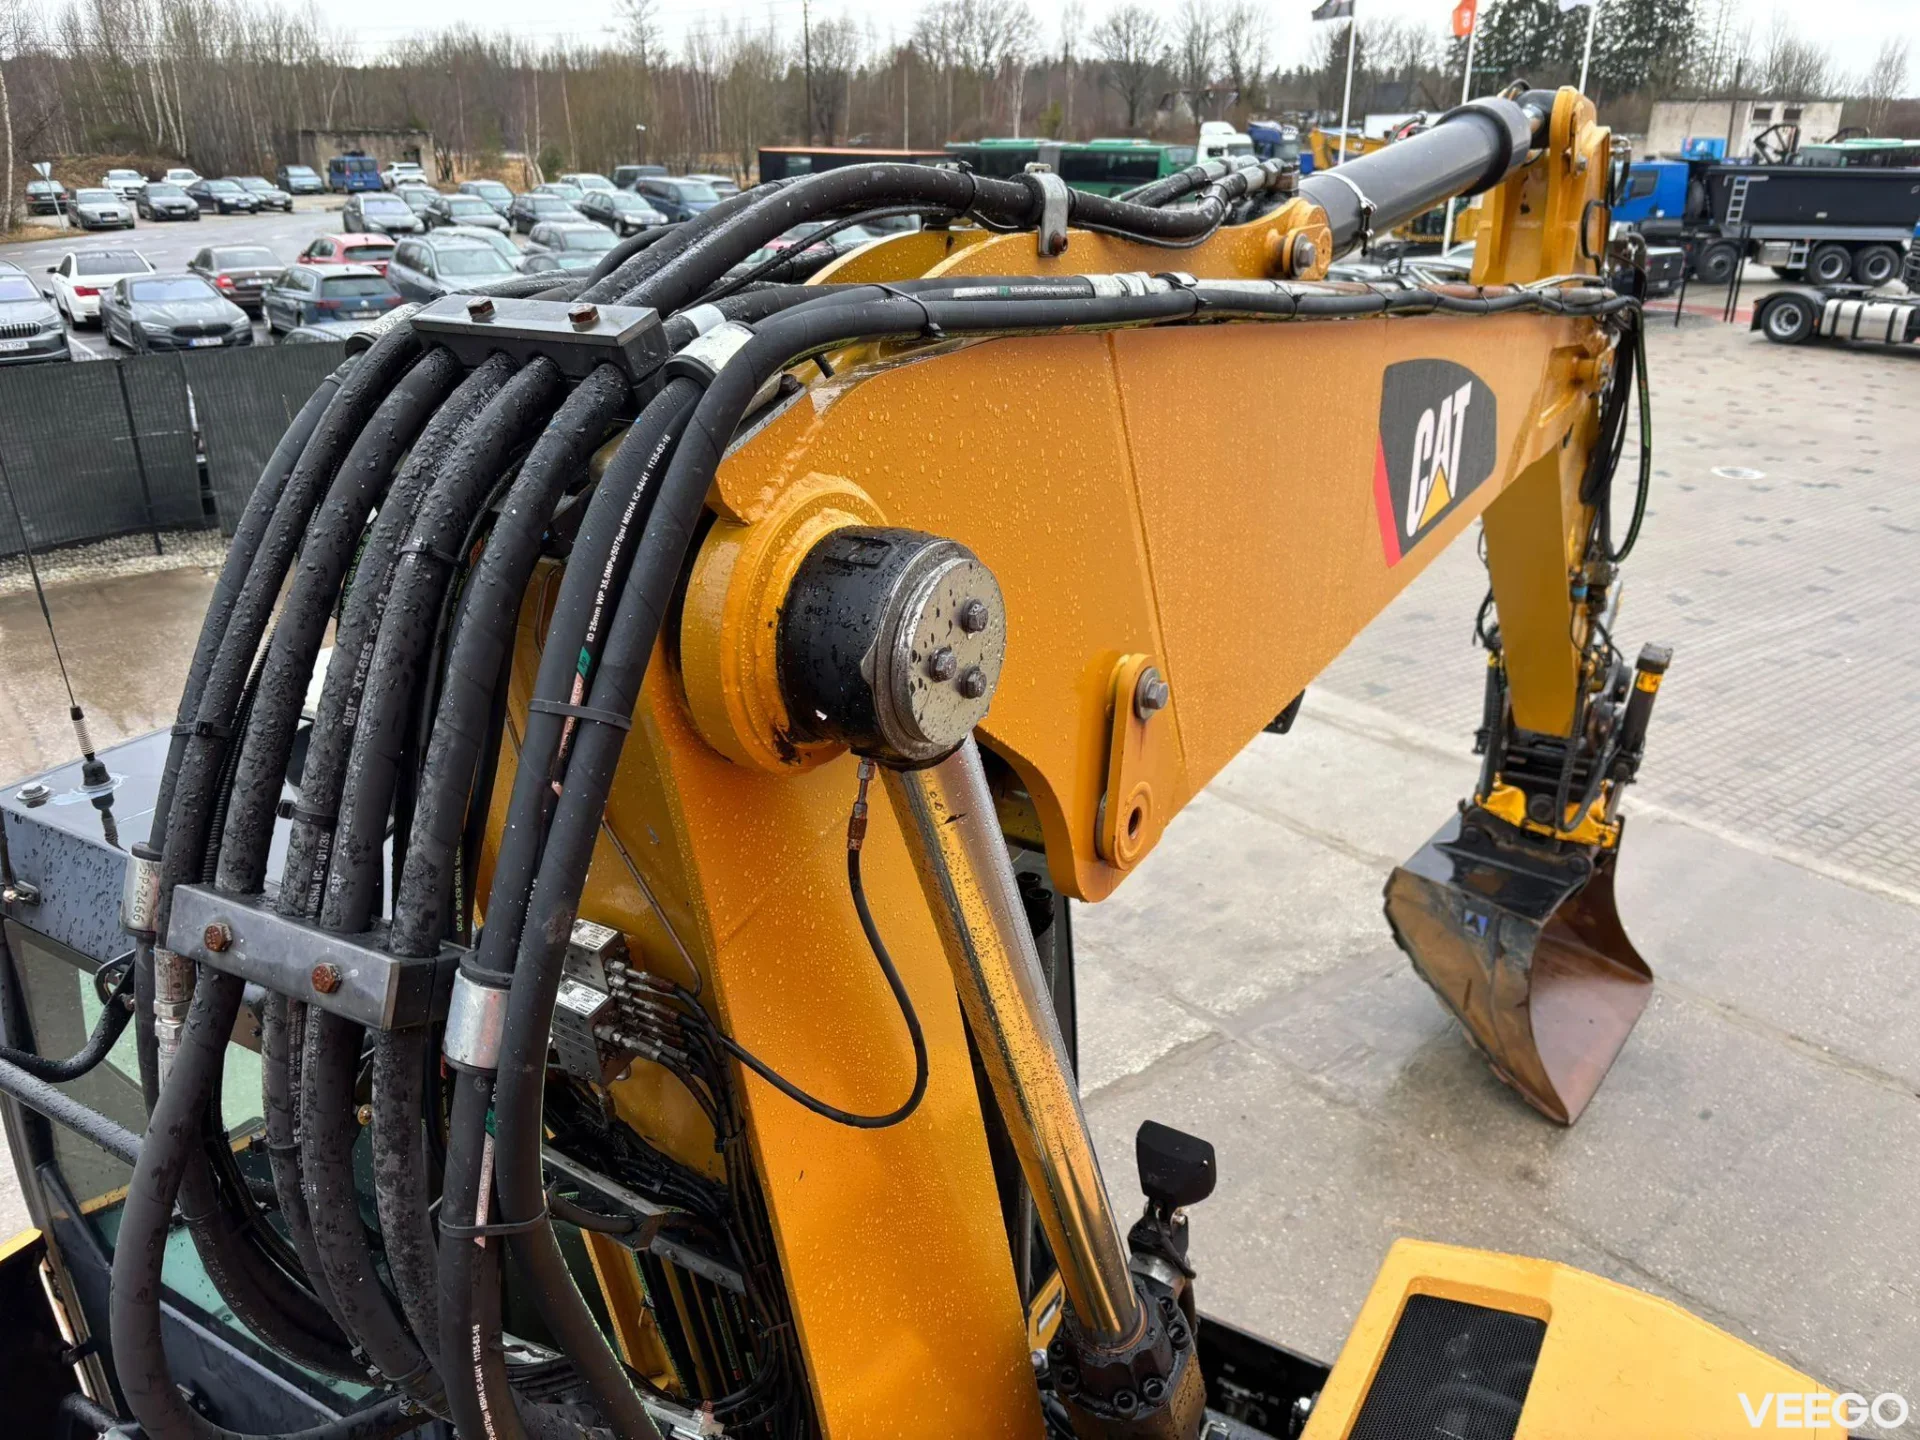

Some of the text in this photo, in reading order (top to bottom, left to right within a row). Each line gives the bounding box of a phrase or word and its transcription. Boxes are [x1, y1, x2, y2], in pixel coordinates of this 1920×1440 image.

[648, 434, 671, 470] 1135-83-16
[1406, 381, 1472, 537] CAT
[632, 472, 651, 502] IC-84/41
[622, 501, 637, 526] MSHA
[595, 589, 604, 606] WP
[589, 606, 602, 632] 25mm
[586, 632, 595, 643] ID
[352, 642, 374, 690] XT-6ES
[132, 868, 150, 922] 5P-2466
